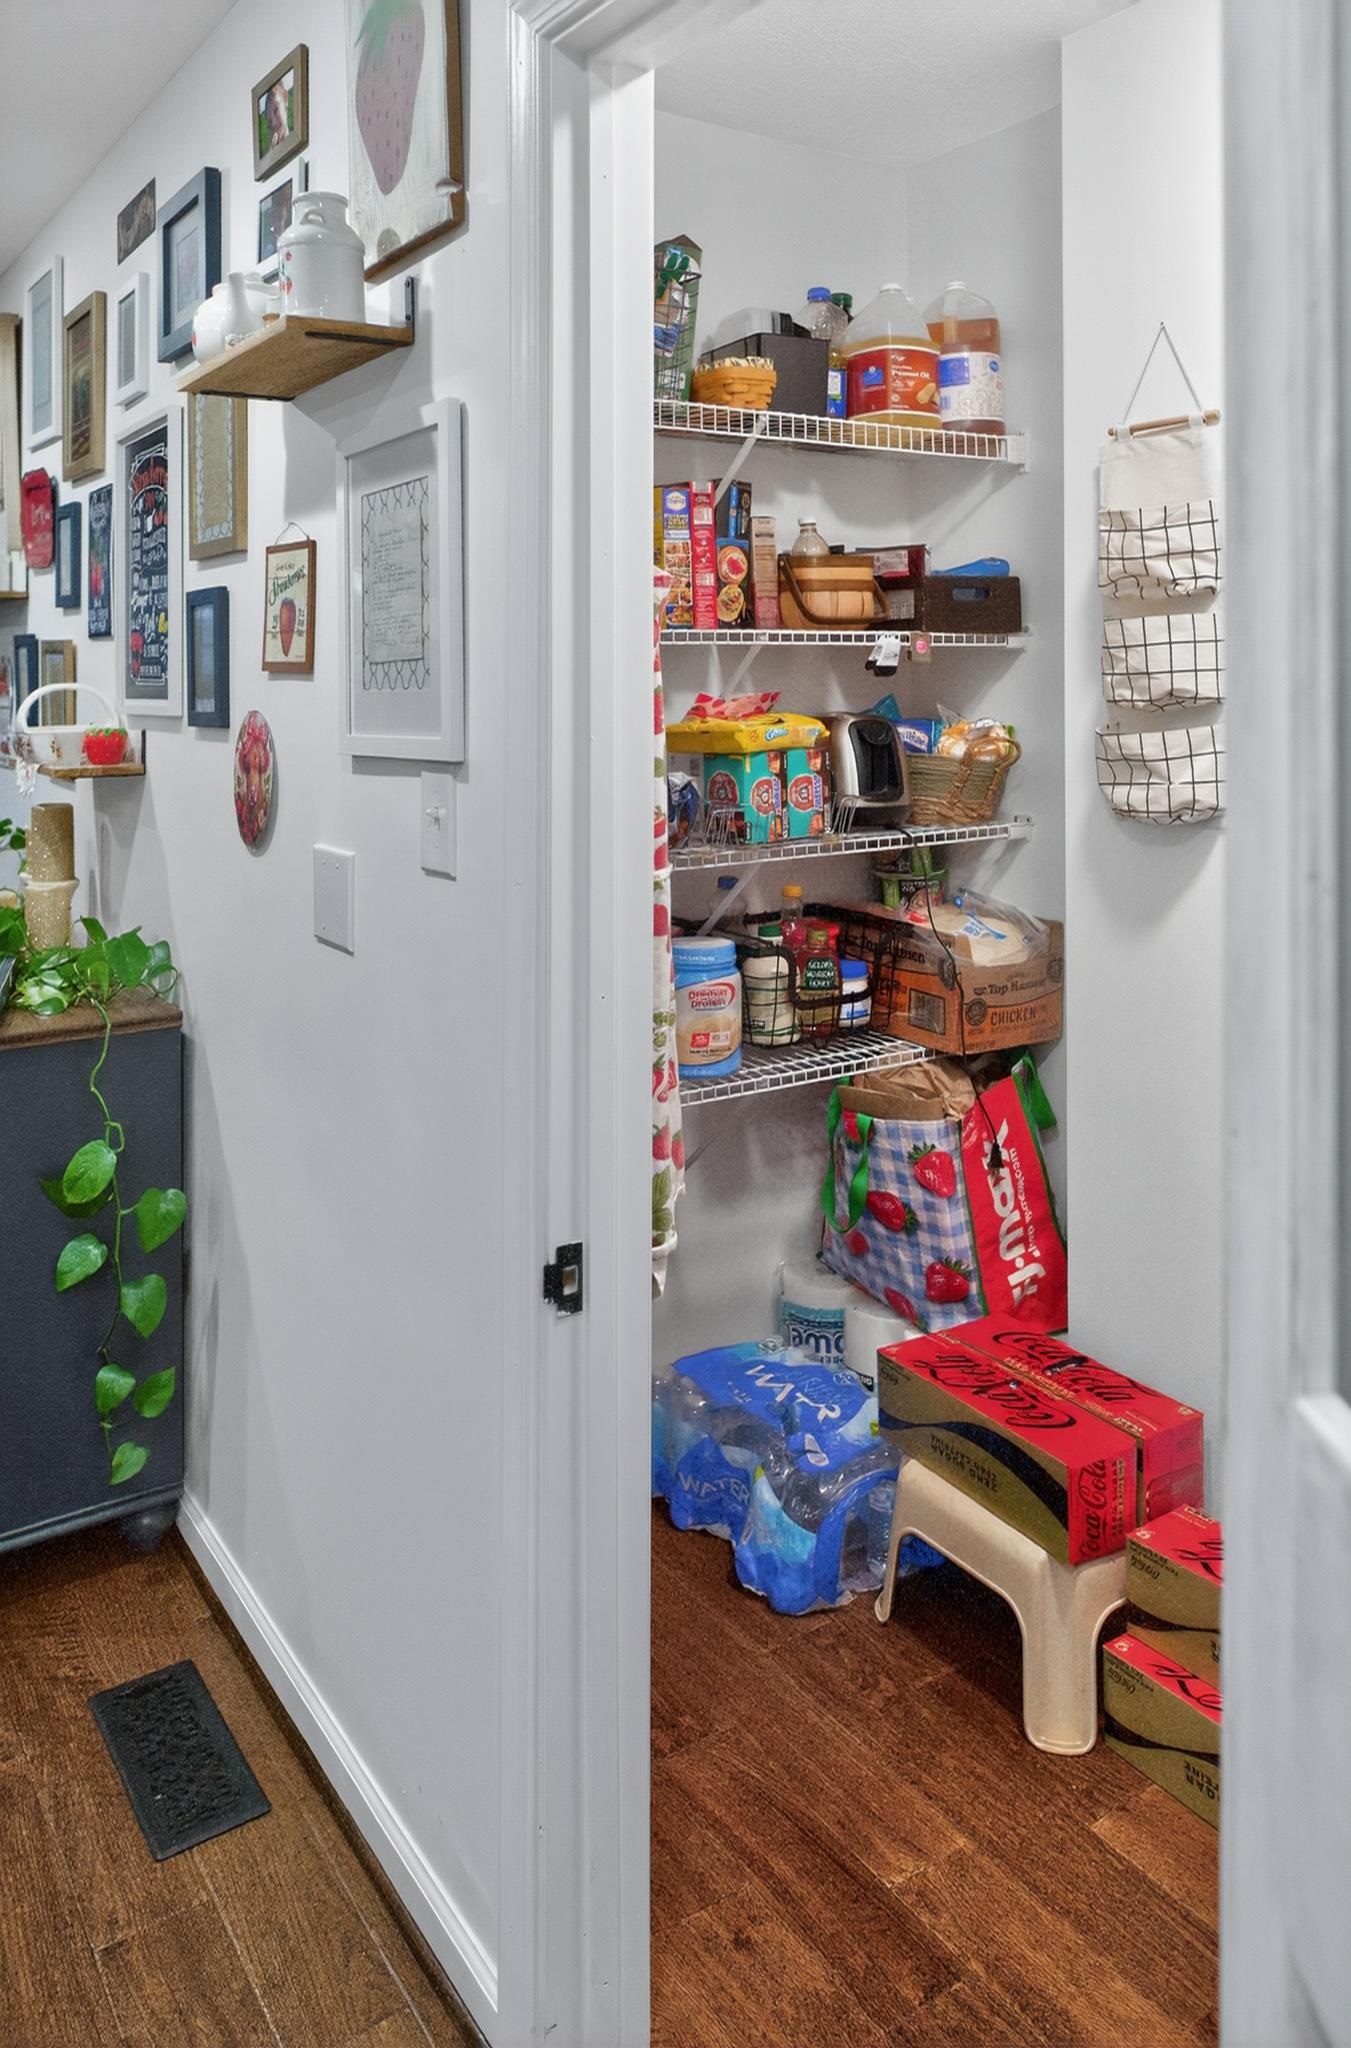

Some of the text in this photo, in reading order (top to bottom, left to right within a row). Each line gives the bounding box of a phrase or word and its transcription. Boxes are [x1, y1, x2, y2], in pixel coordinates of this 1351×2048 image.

[987, 984, 1009, 996] Top
[990, 1006, 1037, 1026] CHICKEN
[678, 1471, 750, 1505] WATER
